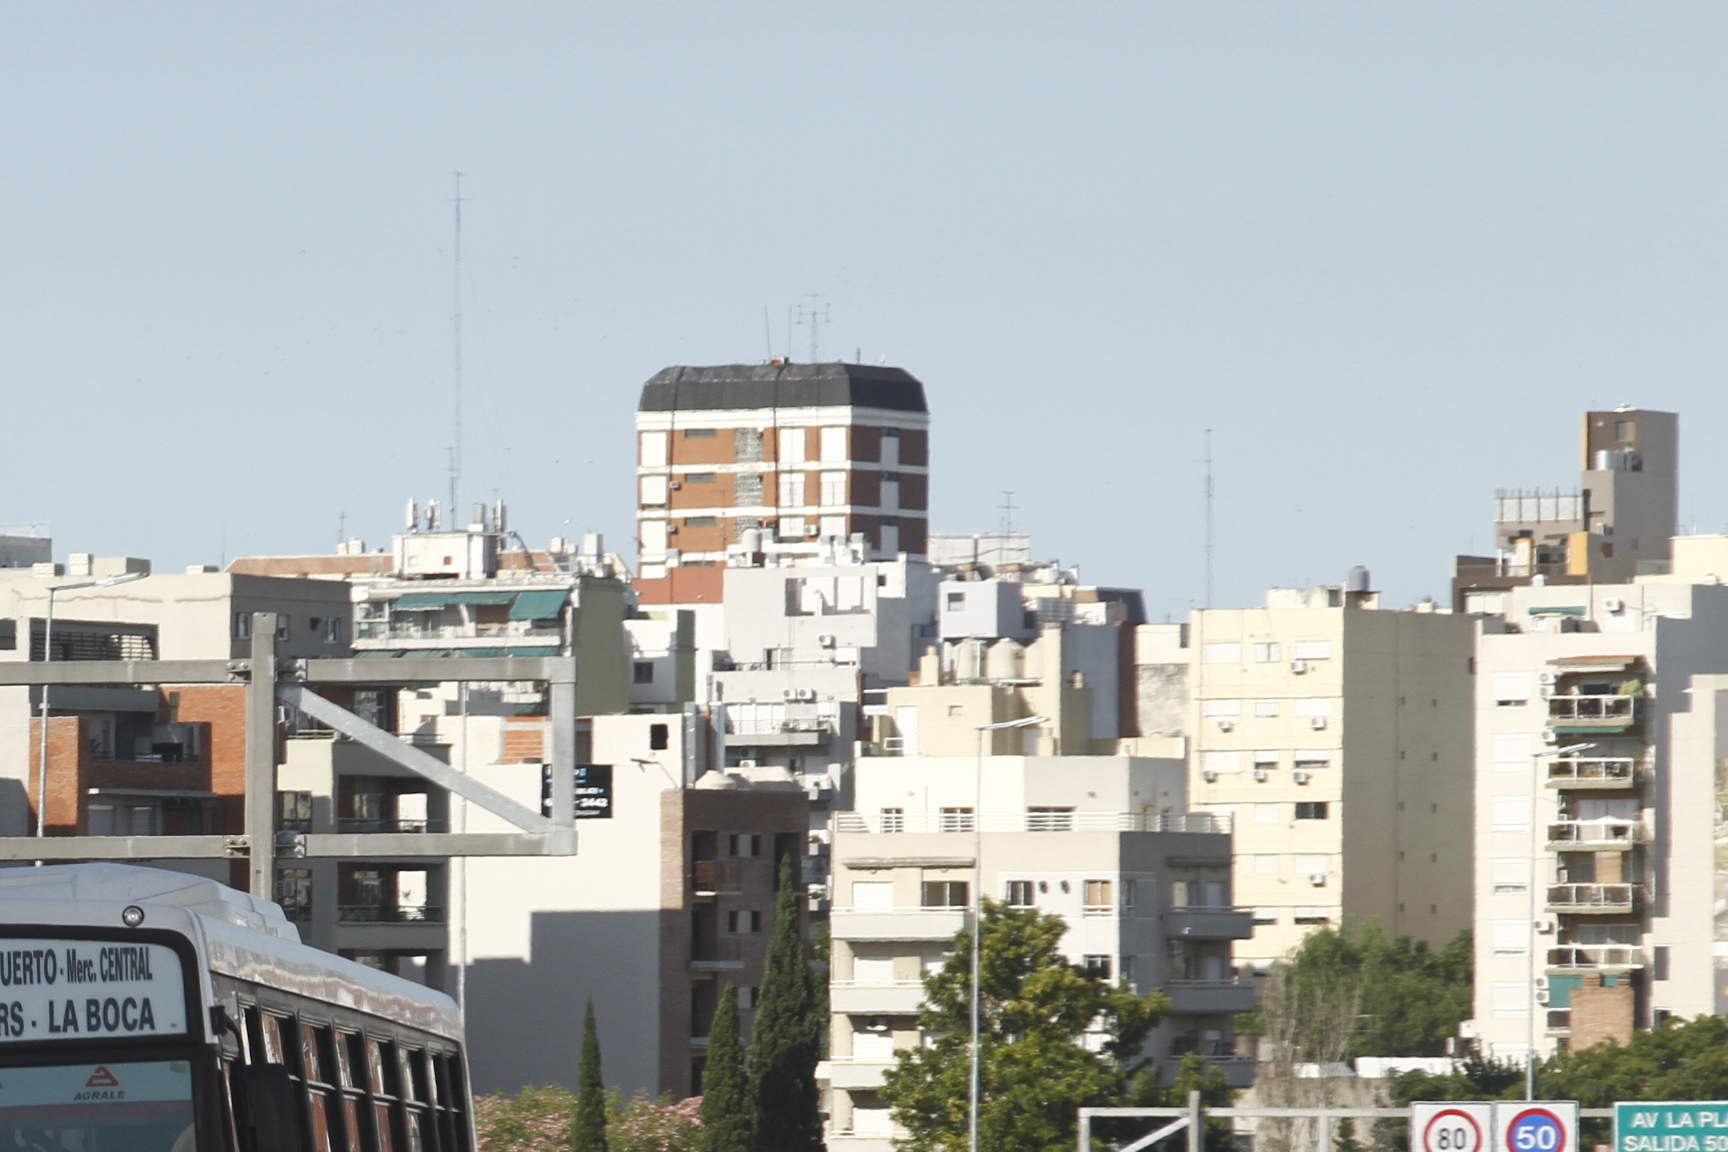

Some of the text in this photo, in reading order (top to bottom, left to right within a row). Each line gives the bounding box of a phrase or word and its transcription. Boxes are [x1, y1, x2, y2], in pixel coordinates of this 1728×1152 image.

[66, 948, 97, 984] Merc.
[99, 946, 153, 983] CENTRAL
[48, 999, 80, 1033] LA
[85, 996, 156, 1032] BOCA
[73, 1090, 126, 1101] AGRALE
[1631, 1111, 1659, 1128] AV
[1665, 1111, 1695, 1128] LA
[1437, 1126, 1467, 1151] 80
[1516, 1125, 1557, 1150] 50
[1623, 1134, 1701, 1152] SALIDA
